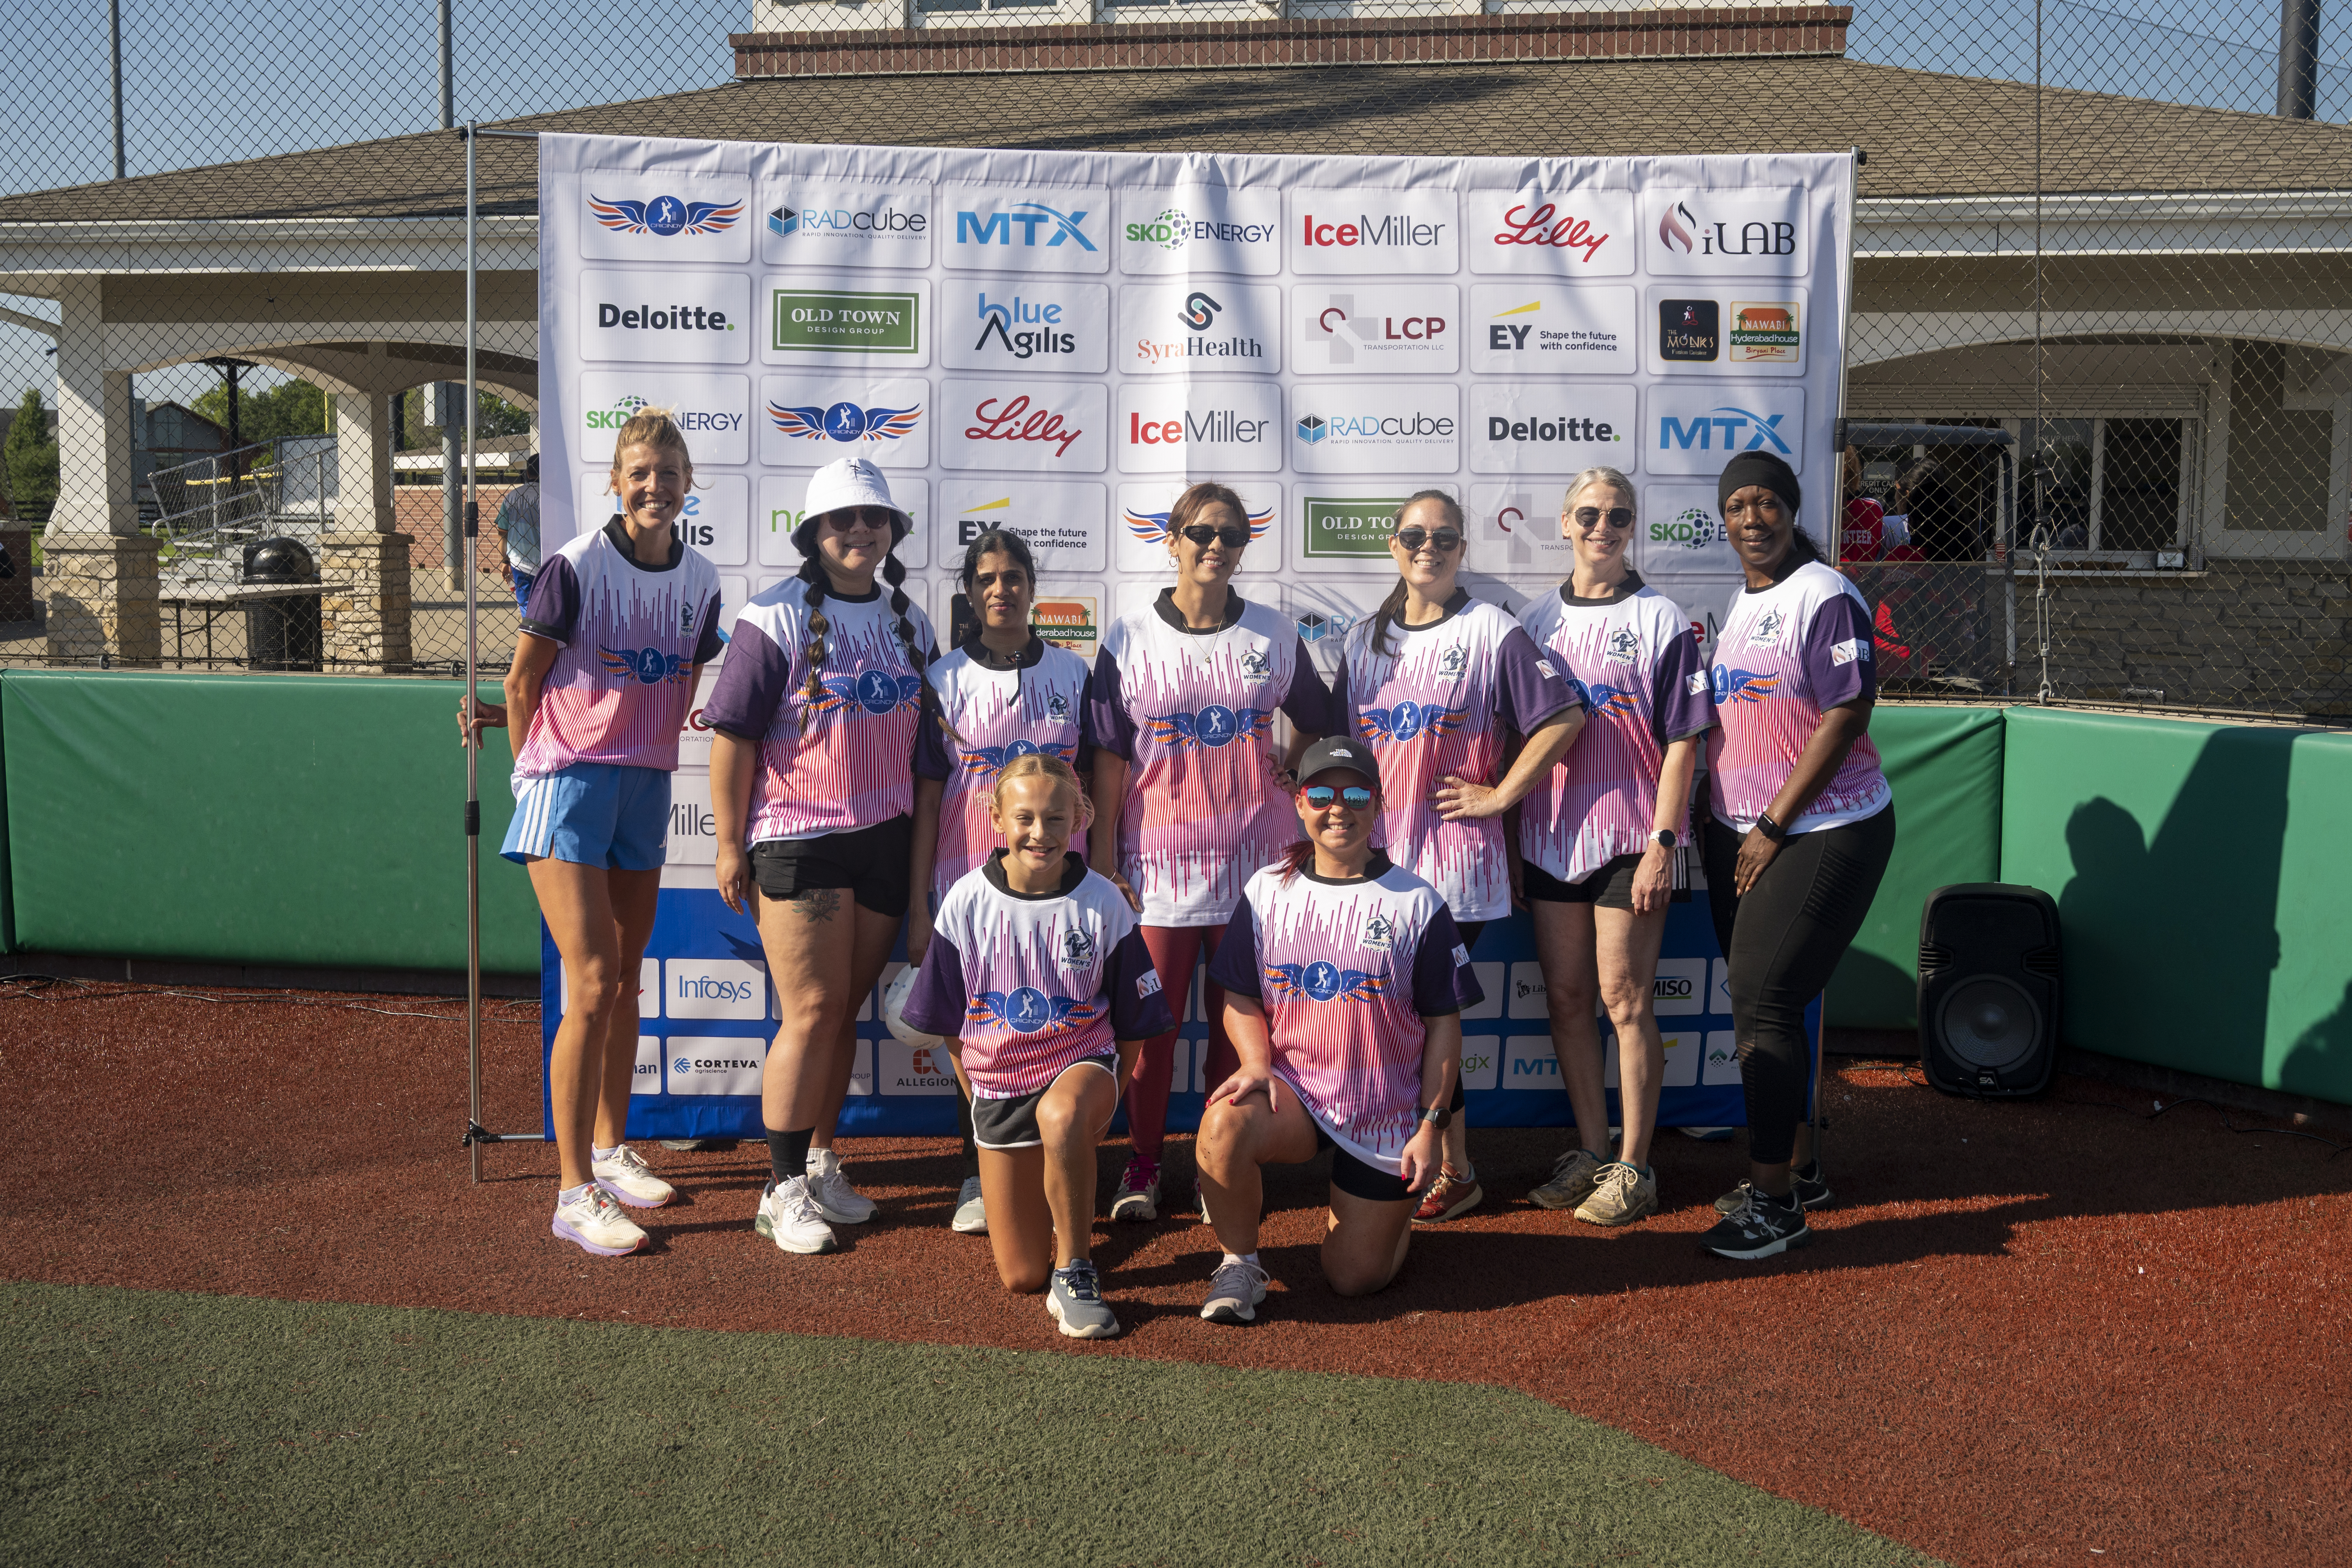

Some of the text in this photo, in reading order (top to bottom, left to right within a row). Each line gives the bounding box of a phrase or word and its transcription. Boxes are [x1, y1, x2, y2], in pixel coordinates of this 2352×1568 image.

[803, 208, 926, 233] RADcube
[957, 203, 1099, 252] MTX
[1126, 222, 1275, 243] SKD ENERGY
[1494, 203, 1610, 263] Lilly
[1702, 222, 1796, 255] iLAB
[599, 303, 735, 331] Deloitte.
[791, 308, 900, 326] OLD TOWN
[979, 292, 1062, 332] blue
[1386, 317, 1446, 340] LCP
[1745, 320, 1785, 330] NAWABI
[1490, 325, 1533, 350] EY
[1540, 331, 1617, 341] Shape the future
[1540, 342, 1617, 351] with confidence
[1745, 346, 1768, 355] Biryani
[678, 412, 742, 431] NERGY
[964, 395, 1082, 458] Lilly
[1331, 411, 1454, 436] RADcube
[1489, 416, 1621, 442] Deloitte.
[1660, 407, 1792, 454] MTX
[1322, 516, 1395, 530] OLD TO
[1650, 523, 1693, 541] SKD
[1009, 527, 1087, 539] Shape the future
[1034, 539, 1087, 549] confidence
[1040, 615, 1081, 624] NAWABI
[1607, 651, 1636, 662] WOMEN'S
[1363, 939, 1391, 948] WOMEN'S
[1061, 957, 1091, 967] WOMEN'S
[679, 975, 752, 1003] Infosys
[896, 1078, 957, 1087] ALLEGION
